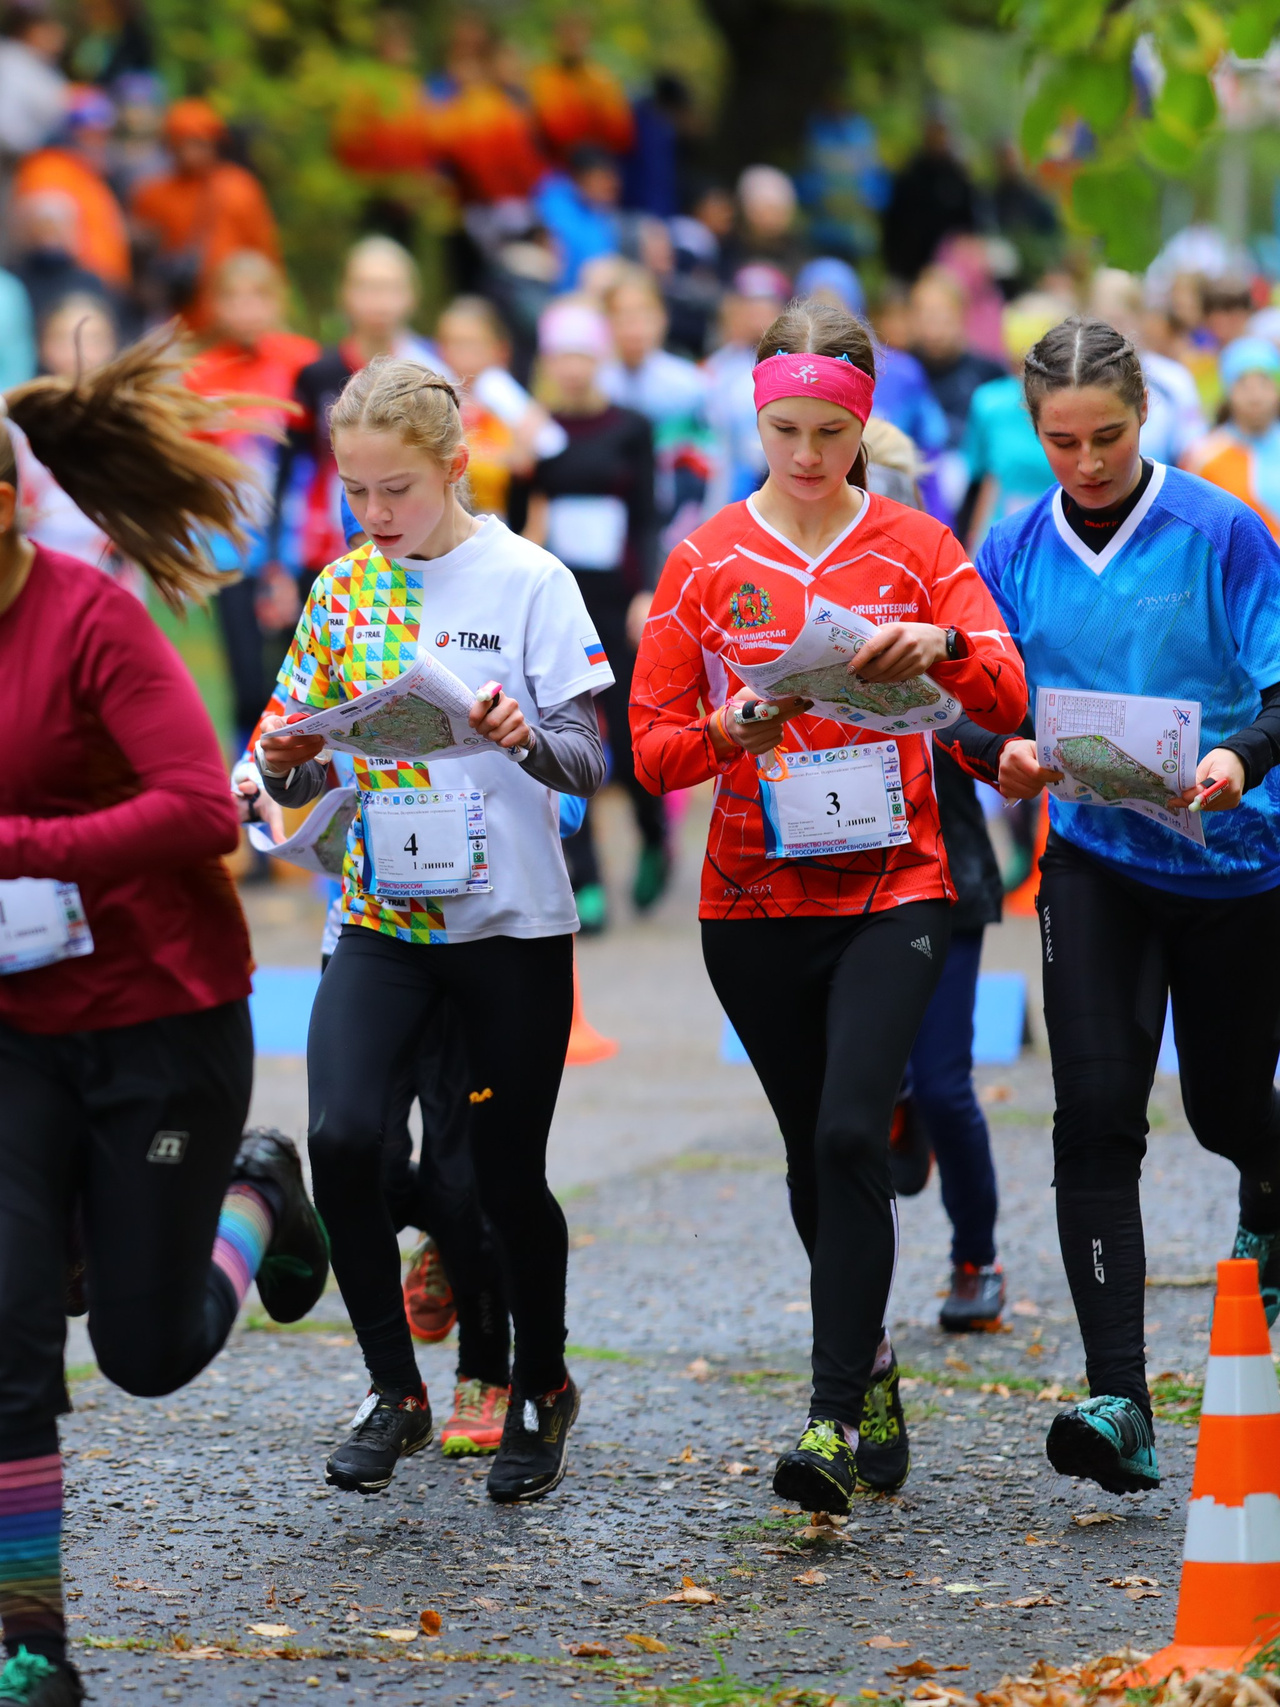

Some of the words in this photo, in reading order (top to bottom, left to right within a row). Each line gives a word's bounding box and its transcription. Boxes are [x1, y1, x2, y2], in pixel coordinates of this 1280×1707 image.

[850, 602, 919, 615] ORIENTEERING
[435, 631, 502, 652] O-TRAIL
[825, 791, 841, 816] 3
[837, 819, 841, 828] 1
[845, 816, 877, 827] линия
[468, 828, 486, 836] evo
[404, 833, 418, 856] 4
[784, 840, 822, 850] ПЕРВЕНСТВО
[823, 838, 847, 848] РОССИИ
[835, 841, 883, 853] СОРЕВНОВАНИЯ
[413, 861, 417, 870] 1
[421, 862, 454, 870] линия
[411, 887, 459, 896] СОРЕВНОВАНИЯ
[911, 940, 933, 960] adidas
